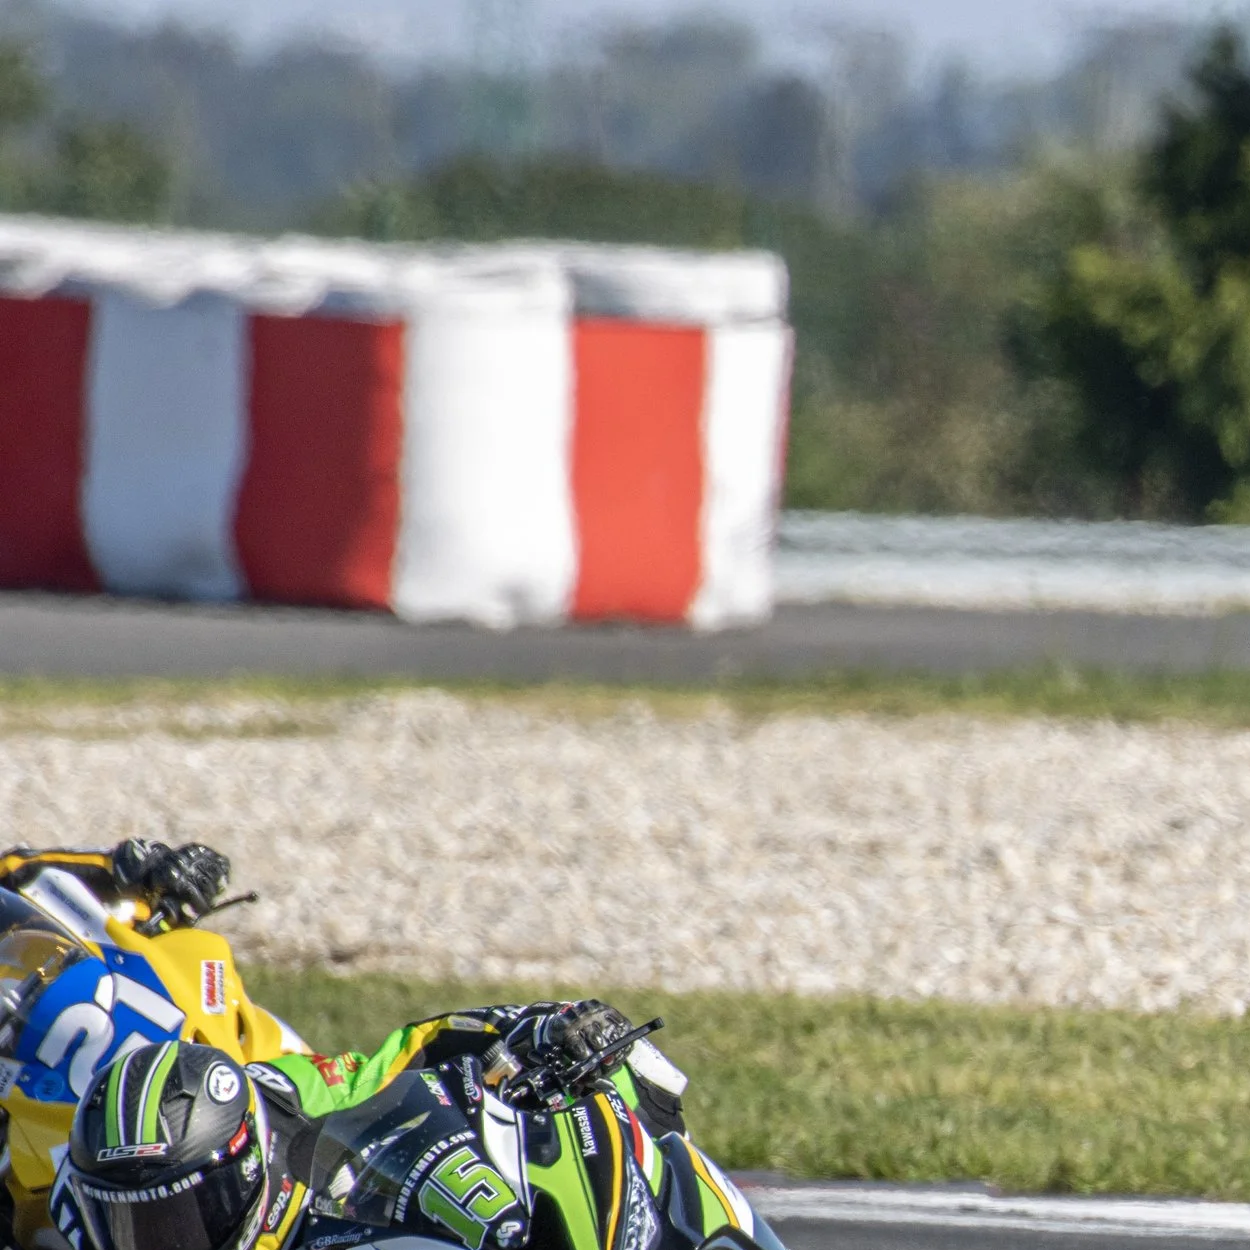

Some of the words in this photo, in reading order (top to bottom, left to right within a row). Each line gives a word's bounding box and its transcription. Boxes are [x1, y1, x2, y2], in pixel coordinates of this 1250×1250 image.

[572, 1106, 599, 1157] Kawasaki
[97, 1142, 169, 1162] LS2
[315, 1233, 362, 1247] GBRacing
